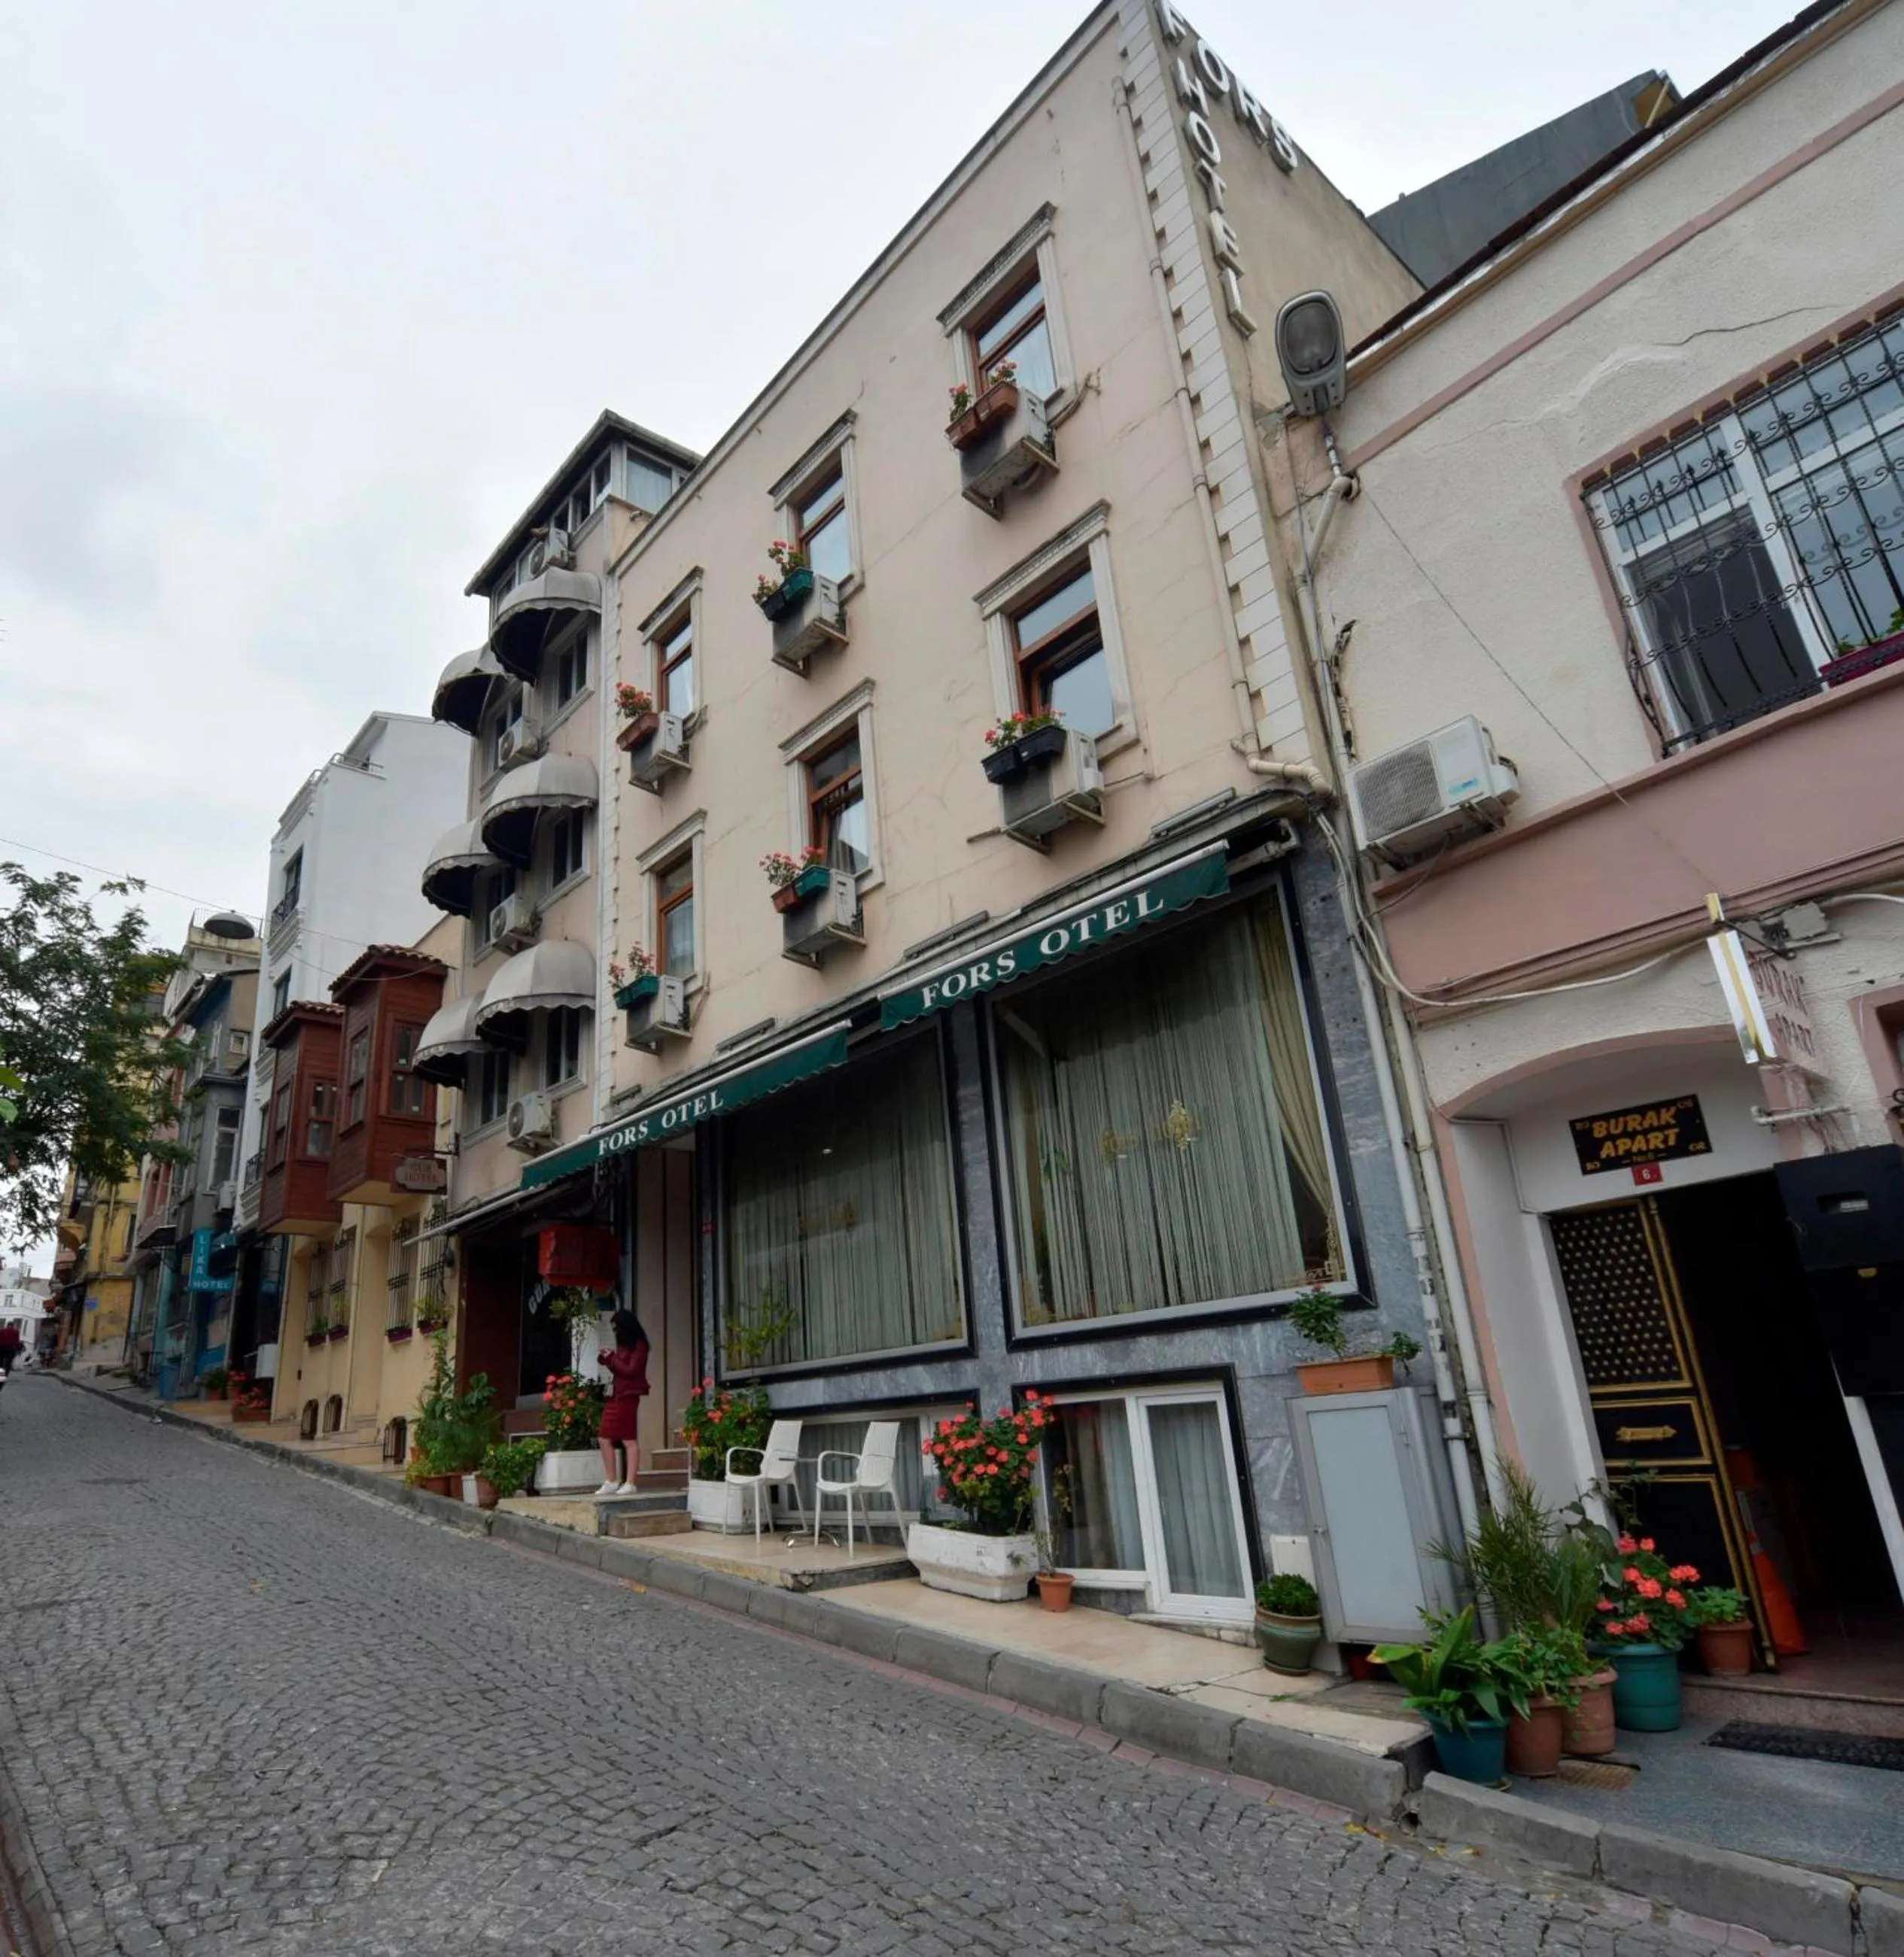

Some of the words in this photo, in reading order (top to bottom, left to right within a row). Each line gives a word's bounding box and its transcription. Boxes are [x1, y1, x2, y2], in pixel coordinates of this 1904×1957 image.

[1154, 0, 1298, 174] FORS
[1172, 57, 1258, 339] HOTEL
[920, 949, 1017, 1009] FORS
[1040, 889, 1165, 956] OTEL
[598, 1120, 649, 1156] FORS
[661, 1089, 724, 1128] OTEL
[1592, 1106, 1678, 1138] BURAK
[1600, 1129, 1680, 1159] APART
[192, 1280, 230, 1289] HOTEL
